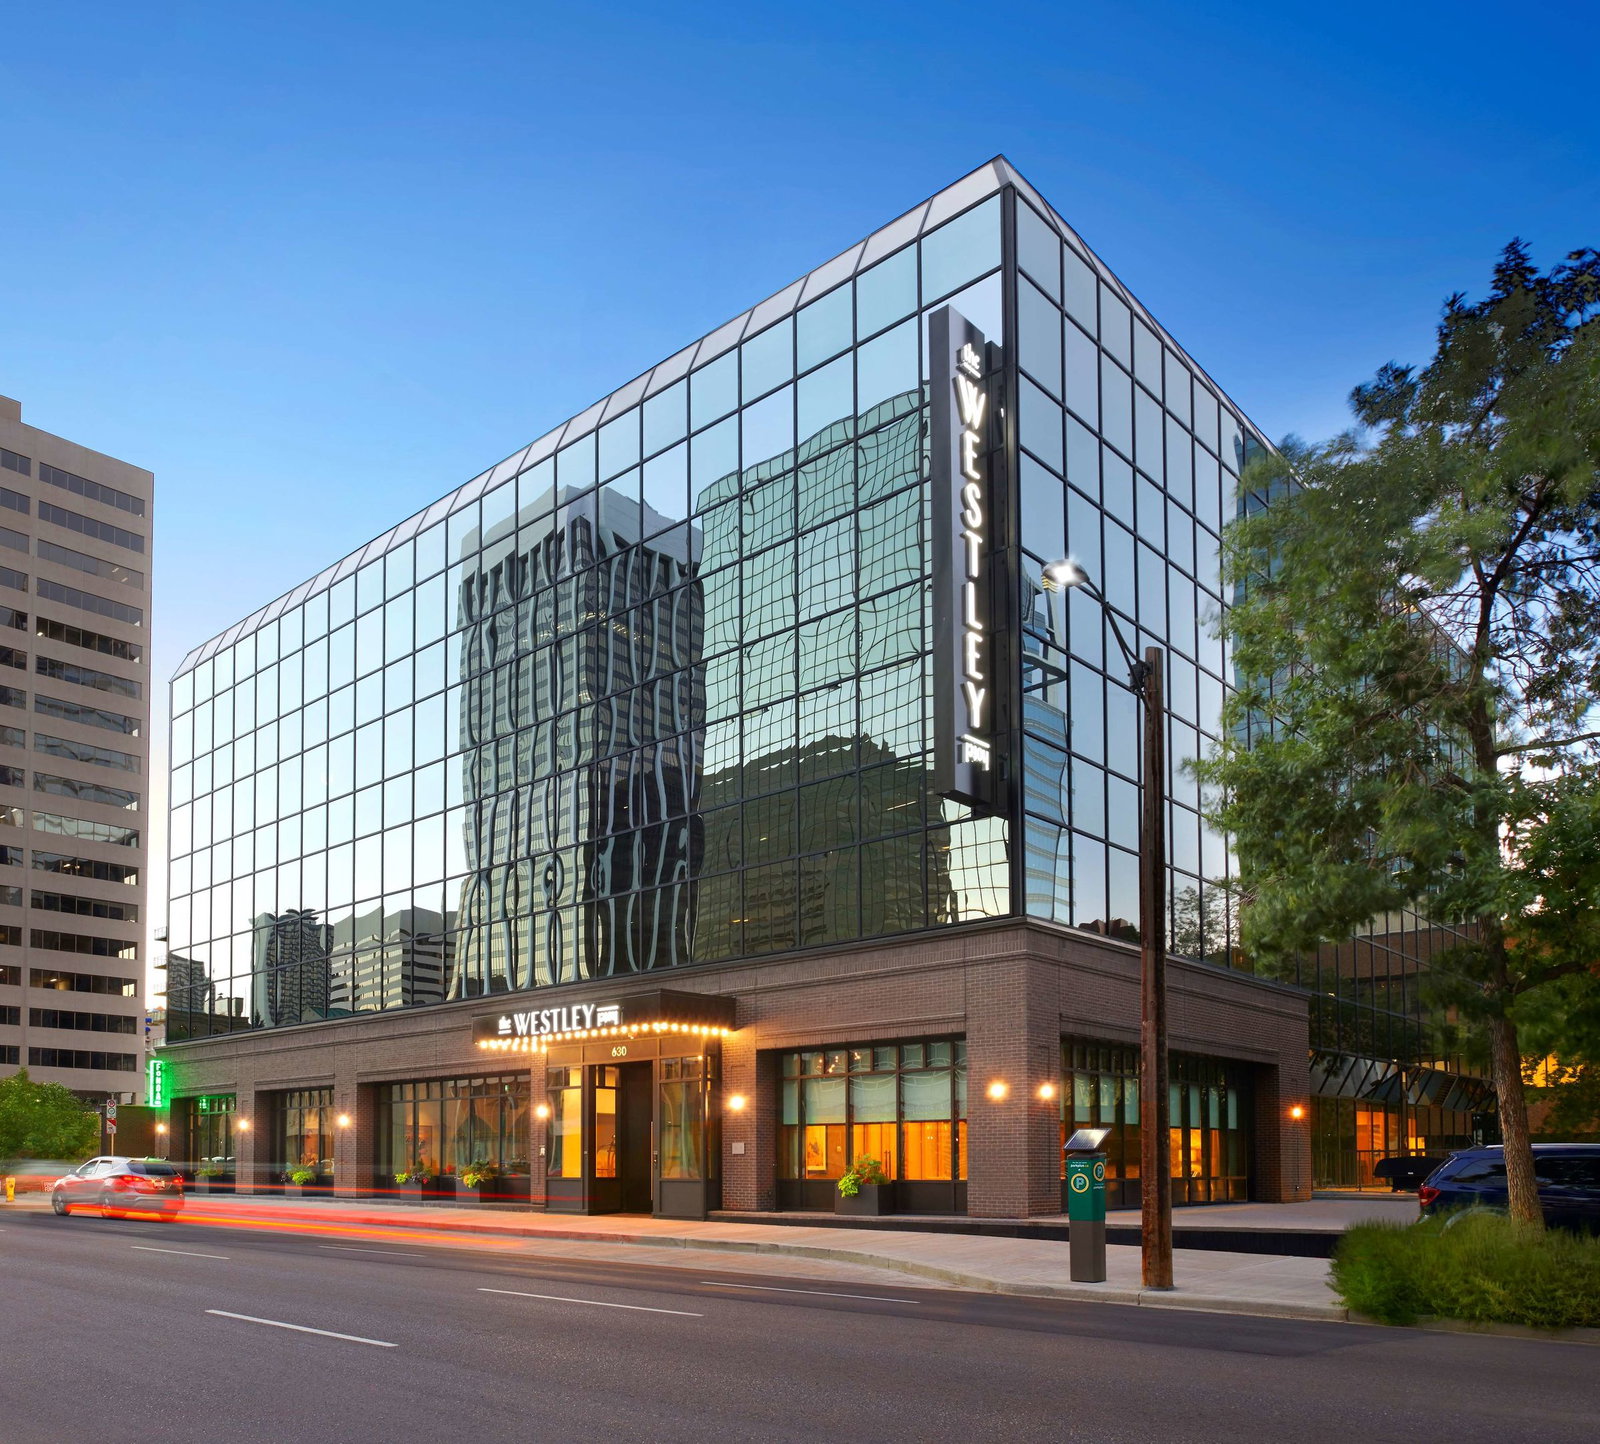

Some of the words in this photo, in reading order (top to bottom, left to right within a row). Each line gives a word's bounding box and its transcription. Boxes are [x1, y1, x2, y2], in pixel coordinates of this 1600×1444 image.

[963, 342, 980, 370] the
[957, 373, 987, 729] WESTLEY
[513, 1003, 596, 1036] WESTLEY
[611, 1046, 627, 1057] 630
